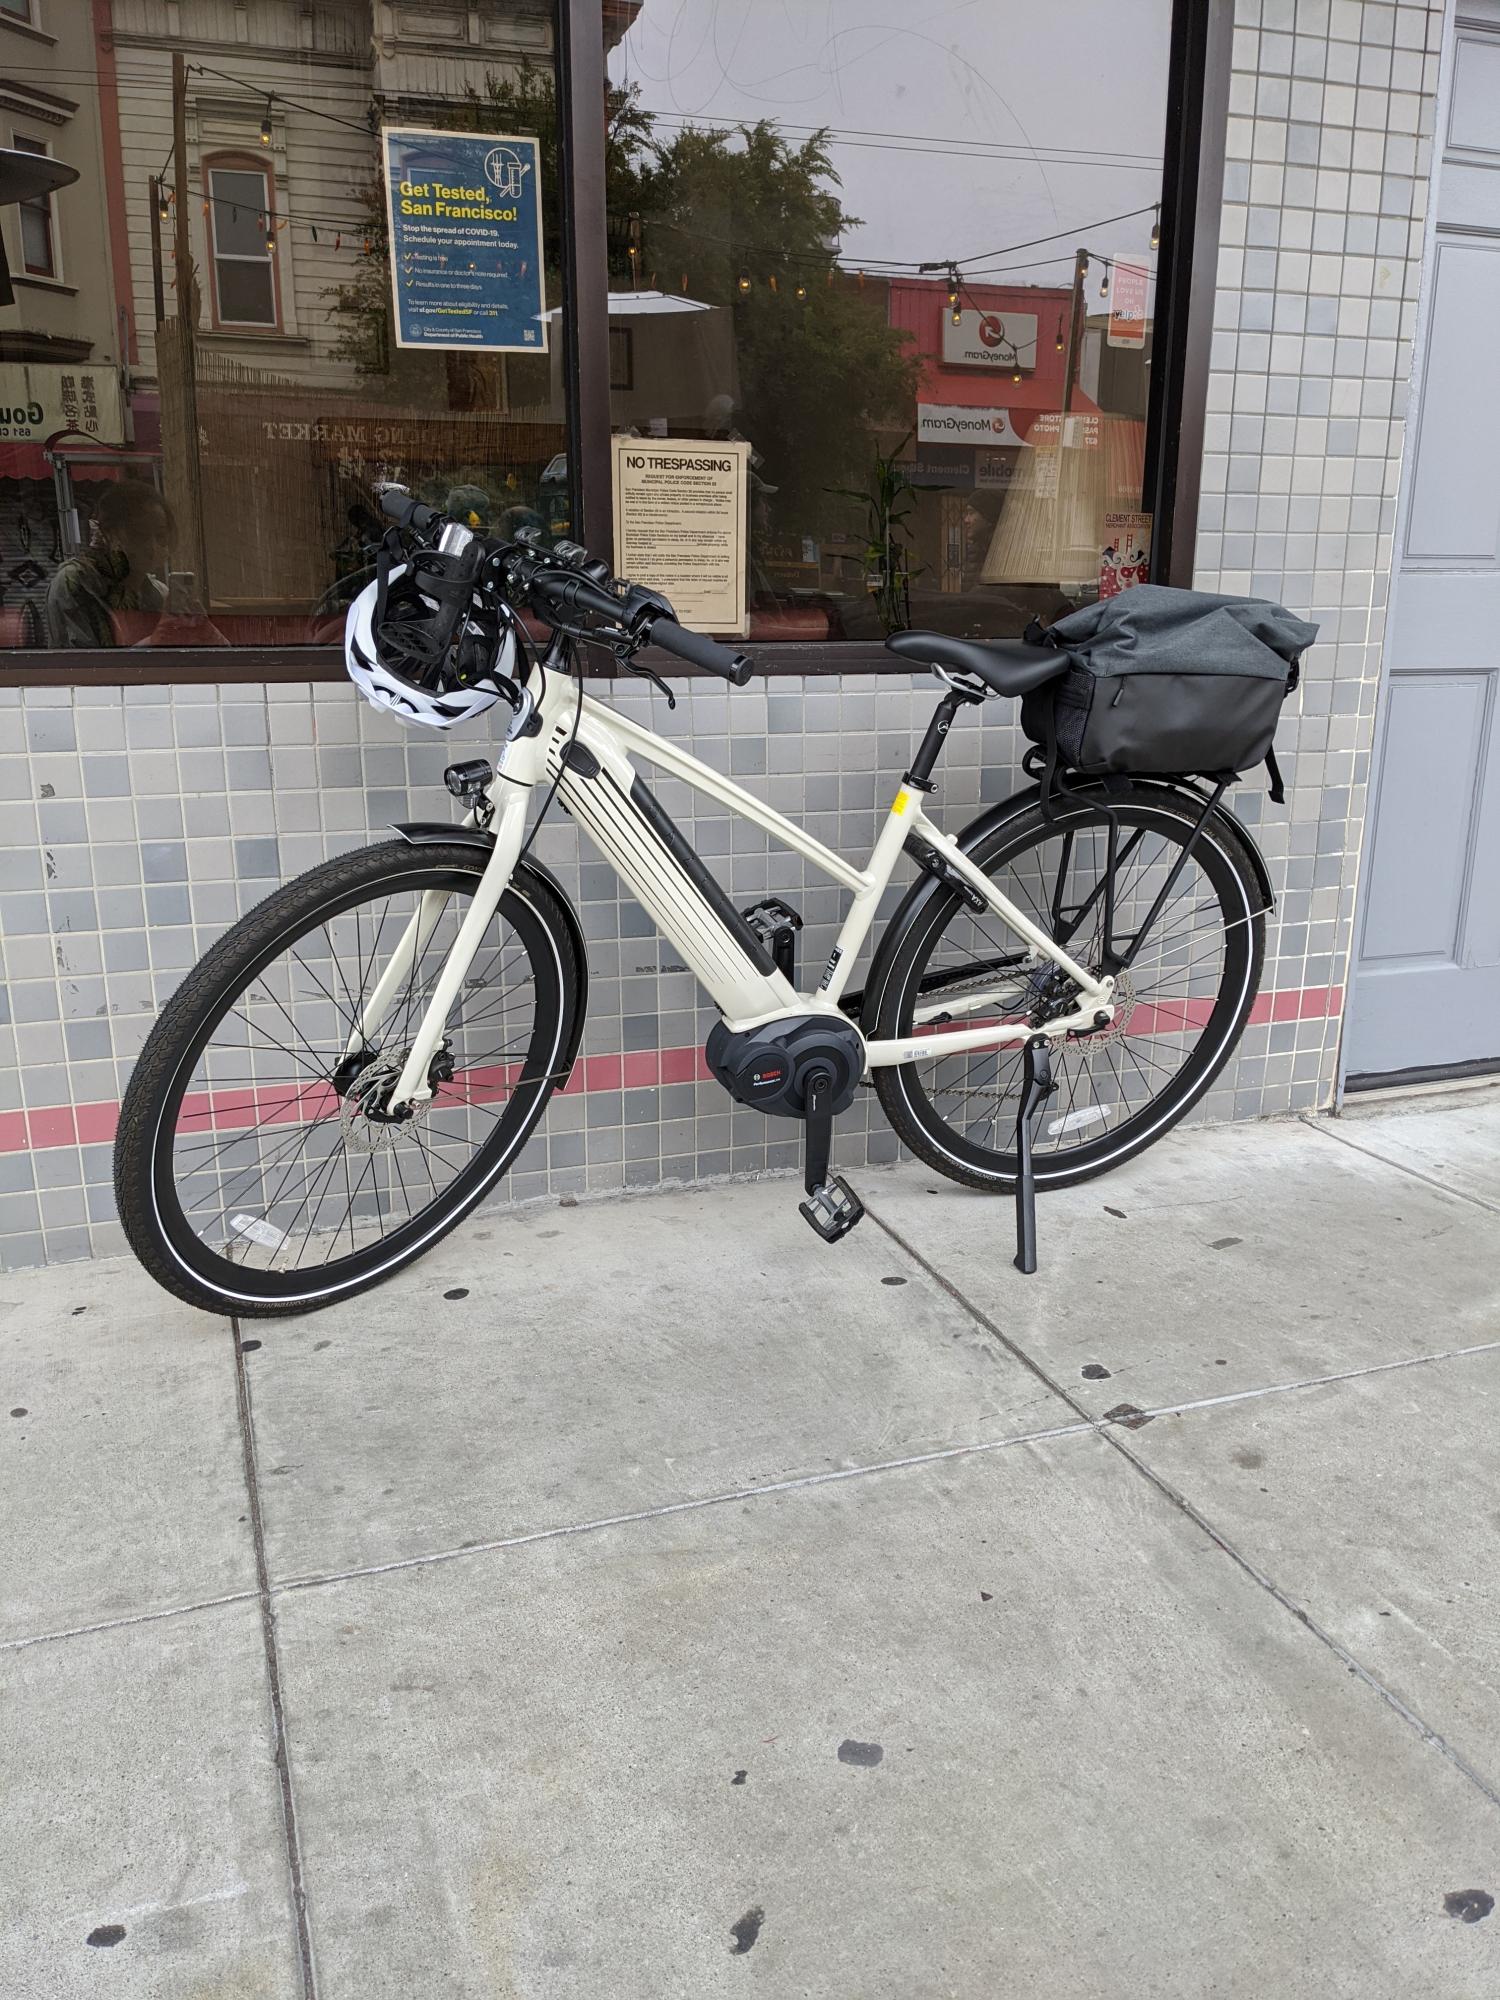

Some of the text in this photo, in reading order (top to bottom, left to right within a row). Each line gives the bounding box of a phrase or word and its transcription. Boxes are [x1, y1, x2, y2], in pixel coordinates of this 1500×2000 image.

[400, 181, 490, 204] Get Tested,
[401, 200, 517, 221] San Francisco!
[402, 224, 500, 237] Stop the spread of COVID-19.
[403, 235, 519, 250] Schedule your appointment today.
[1115, 310, 1133, 320] yelp
[424, 331, 450, 339] Department
[626, 456, 731, 472] NO TRESPASSING
[1105, 513, 1153, 524] CLEMENT STREET
